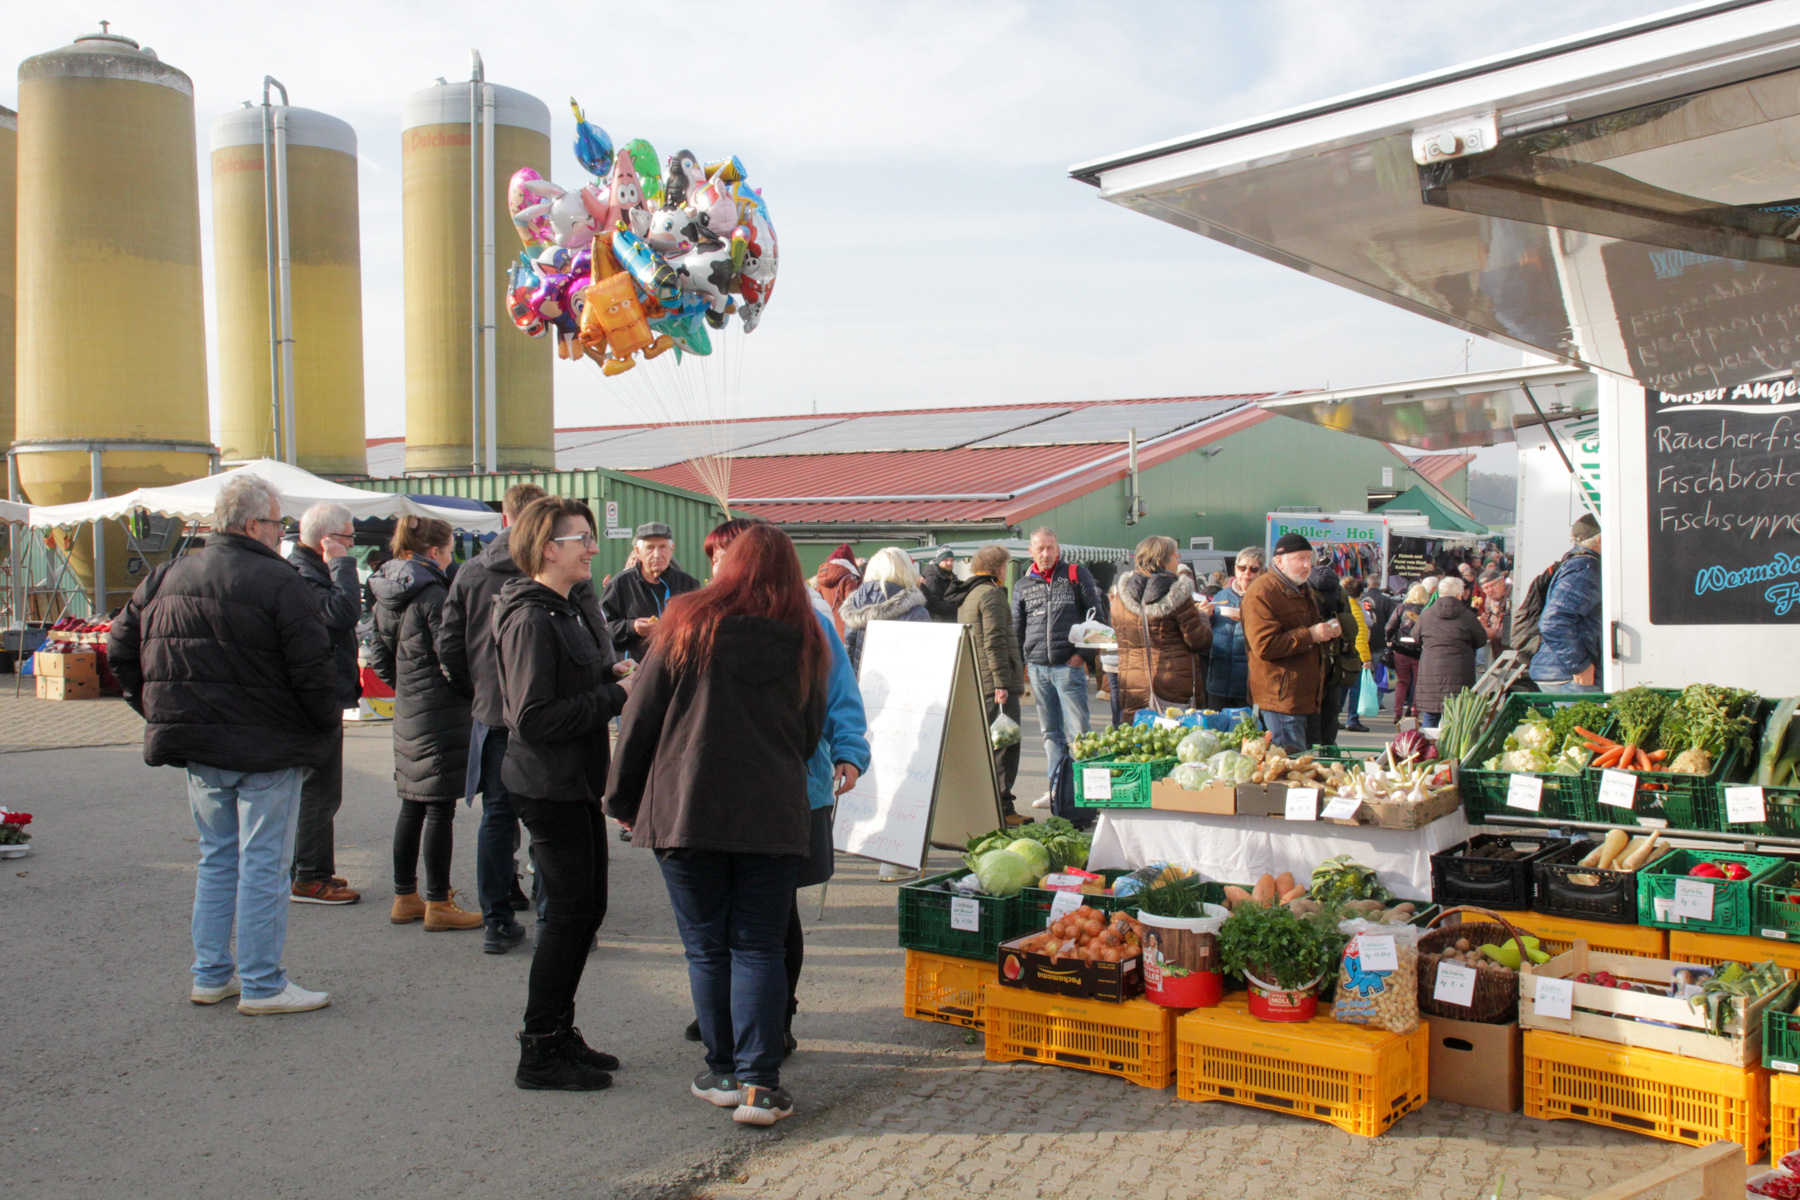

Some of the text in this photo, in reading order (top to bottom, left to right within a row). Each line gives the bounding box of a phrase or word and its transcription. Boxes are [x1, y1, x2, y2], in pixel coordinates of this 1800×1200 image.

[1732, 379, 1800, 404] Ange
[1346, 528, 1375, 540] Hof
[1037, 971, 1082, 986] Pachamama
